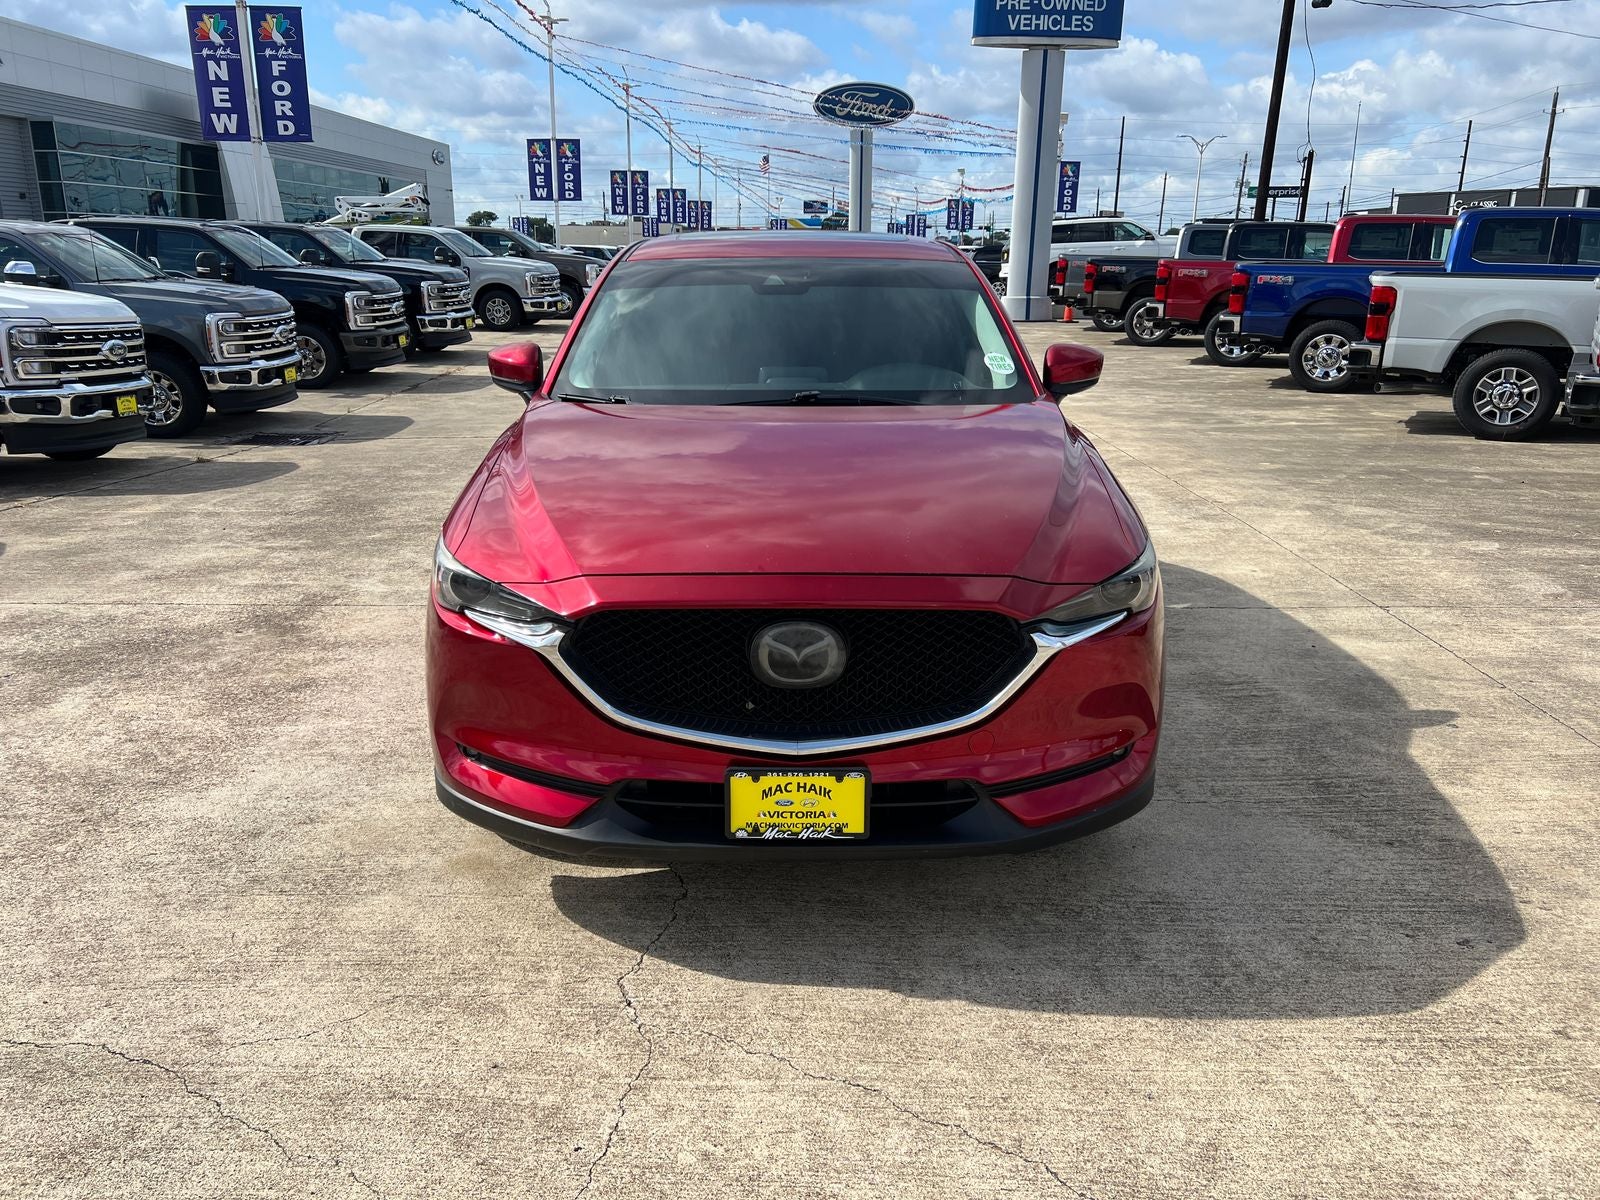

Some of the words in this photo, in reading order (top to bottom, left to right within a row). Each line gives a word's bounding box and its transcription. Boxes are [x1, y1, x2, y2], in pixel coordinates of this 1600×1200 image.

[1007, 14, 1094, 32] VEHICLES
[207, 60, 238, 134] NEW
[271, 60, 296, 136] FORD
[835, 90, 894, 116] Ford
[534, 163, 548, 198] NEW
[563, 163, 575, 199] FORD
[615, 188, 625, 213] NEW
[636, 188, 644, 214] FORD
[1062, 181, 1073, 211] FORD
[660, 202, 668, 222] NEW
[949, 211, 957, 229] NEW
[1257, 275, 1295, 285] FX4
[988, 362, 1014, 371] TIRES
[761, 781, 793, 800] MAC
[796, 781, 832, 800] HAIK
[767, 810, 827, 819] VICTORIA
[758, 827, 797, 840] Mac
[798, 827, 841, 840] Haik
